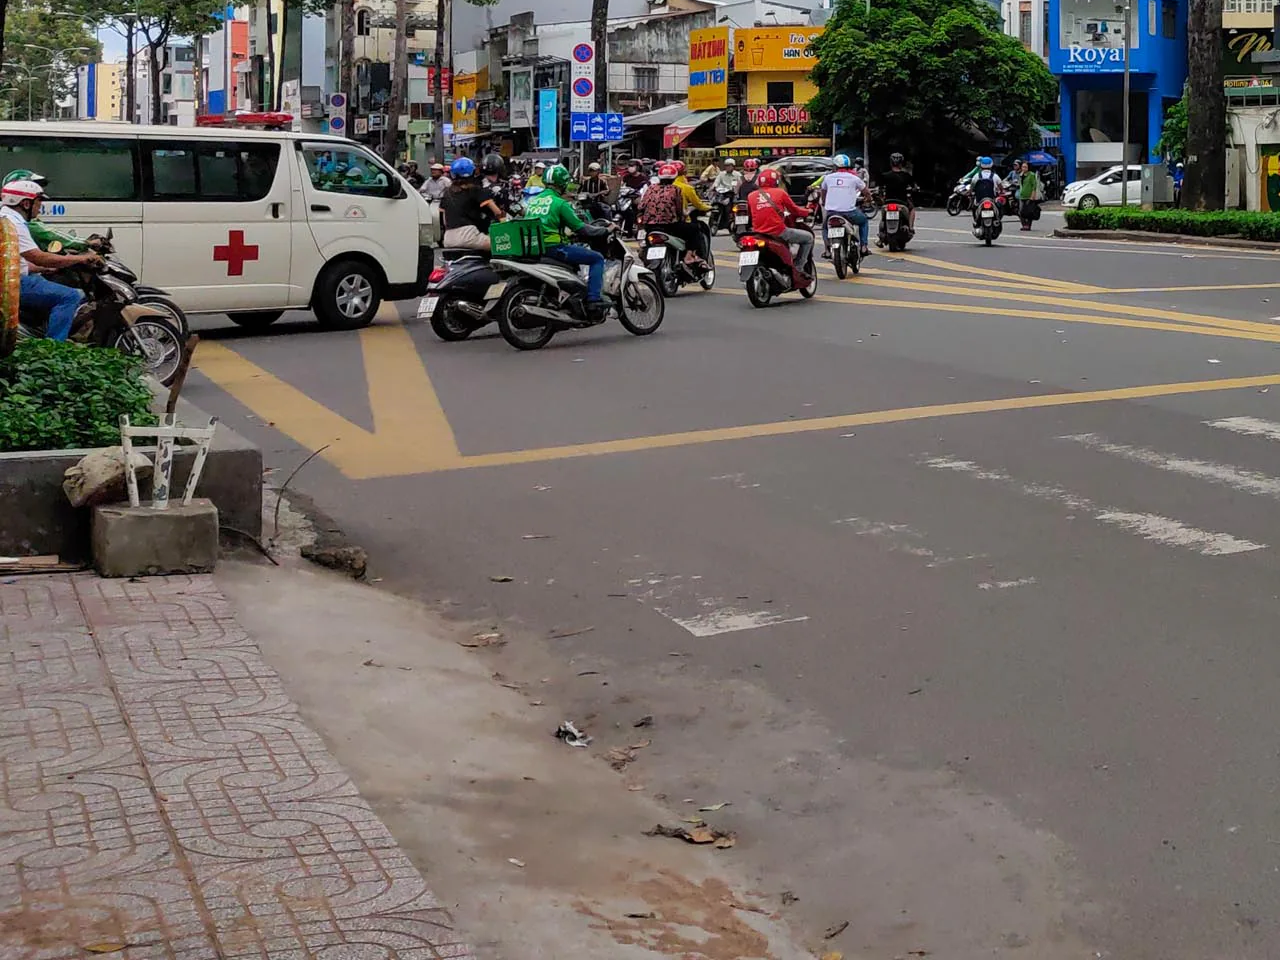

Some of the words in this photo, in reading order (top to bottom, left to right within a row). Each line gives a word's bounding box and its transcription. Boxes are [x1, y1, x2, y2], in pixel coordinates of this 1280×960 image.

[1068, 42, 1126, 65] Royal
[747, 106, 777, 123] TRÀ
[778, 105, 809, 123] SỮA
[753, 124, 774, 135] HÀN
[775, 123, 802, 135] QUỐC
